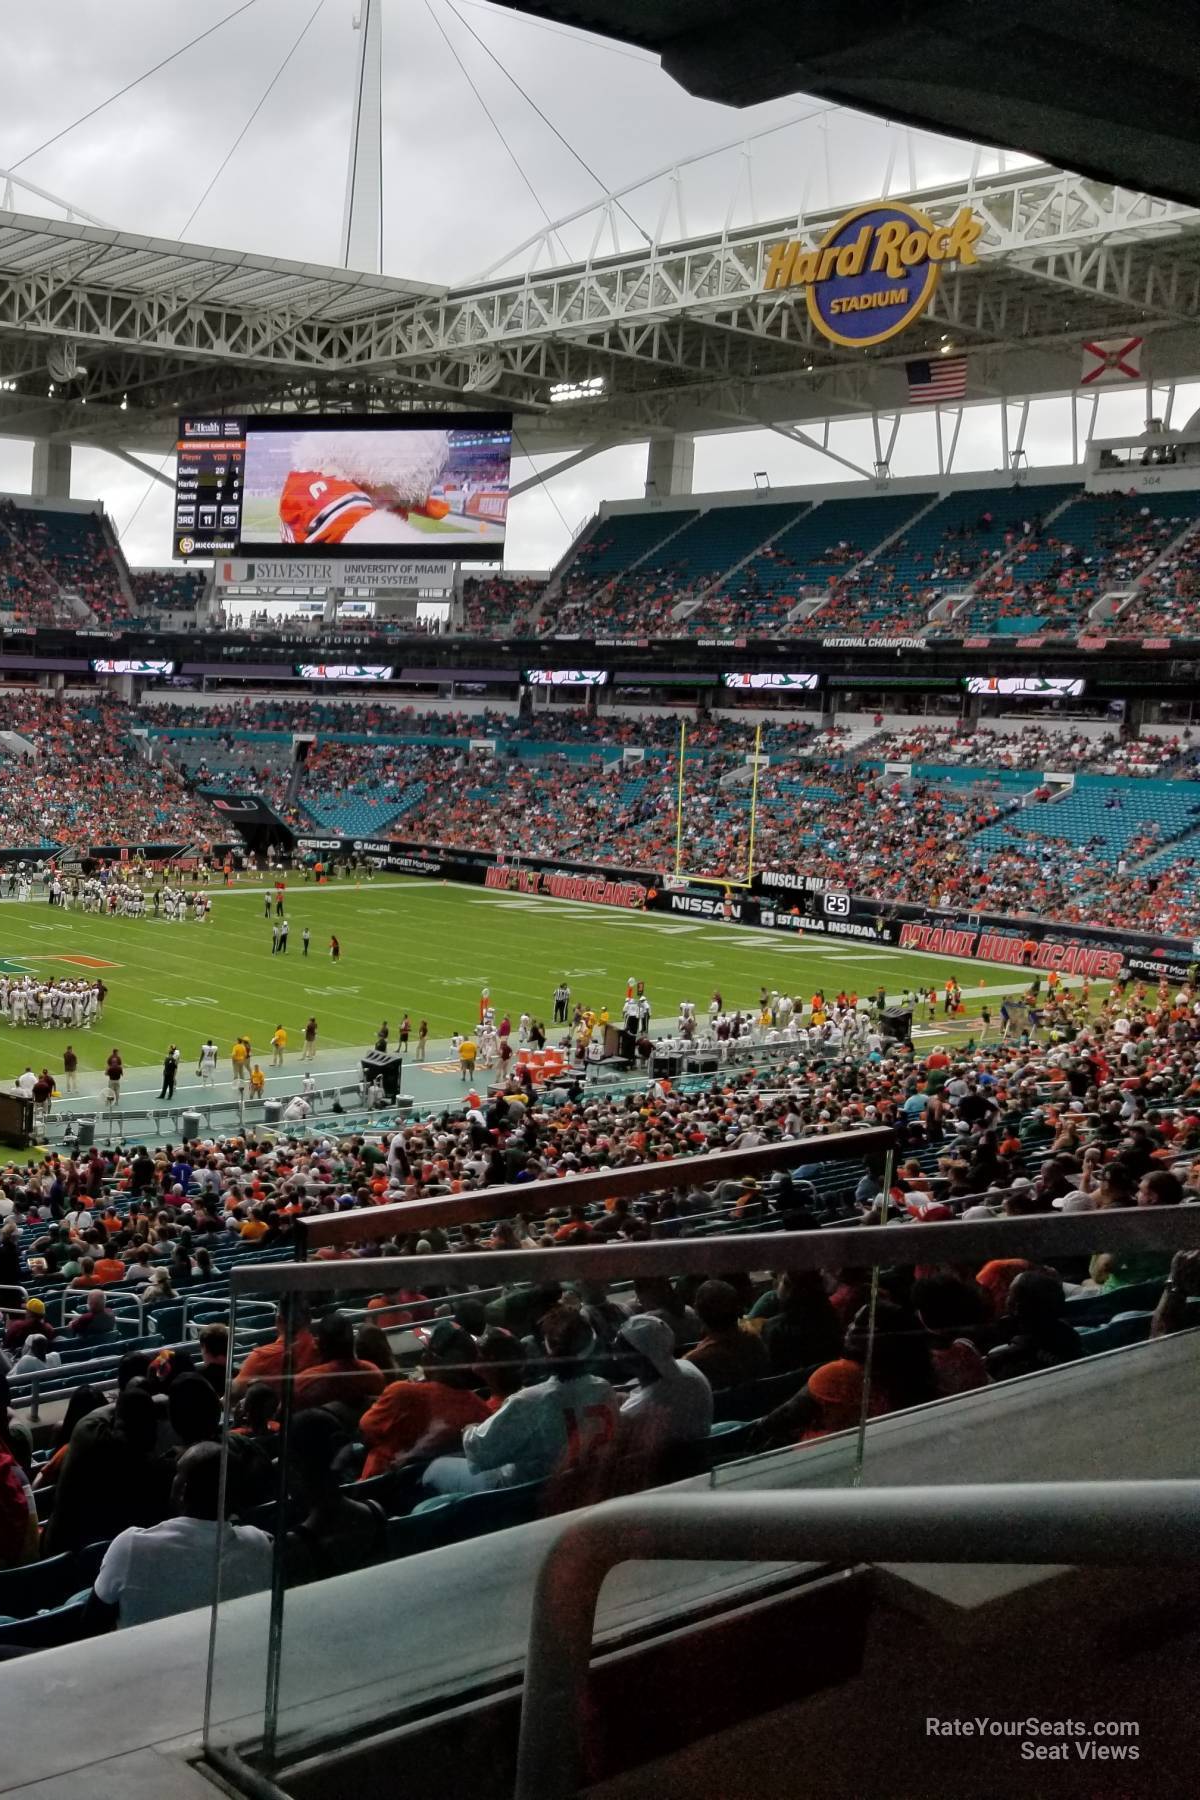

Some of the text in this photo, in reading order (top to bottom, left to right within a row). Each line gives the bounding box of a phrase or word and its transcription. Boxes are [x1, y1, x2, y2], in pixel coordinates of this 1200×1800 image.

[763, 206, 984, 290] Hard Rock
[829, 288, 908, 315] STADIUM
[215, 467, 225, 475] 20
[233, 480, 239, 488] 0
[1143, 477, 1161, 485] 304
[216, 492, 222, 500] 2
[232, 492, 238, 500] 0
[177, 516, 194, 524] 3RD
[203, 515, 212, 525] 11
[223, 515, 236, 525] 33
[256, 564, 332, 578] SYLVESTER
[344, 564, 447, 575] UNIVERSITY OF MIAMI
[344, 575, 418, 585] HEALTH SYSTEM
[324, 636, 370, 645] HONOR
[822, 637, 927, 649] NATIONAL CHAMPIONS
[297, 839, 341, 849] GEICO
[388, 856, 413, 866] ROCKET
[412, 860, 441, 872] Mortgage
[762, 871, 804, 889] MUSCLE
[828, 898, 846, 912] 25
[828, 921, 891, 940] INSURANE
[899, 924, 977, 957] MIAMI
[1129, 959, 1169, 973] ROCKET
